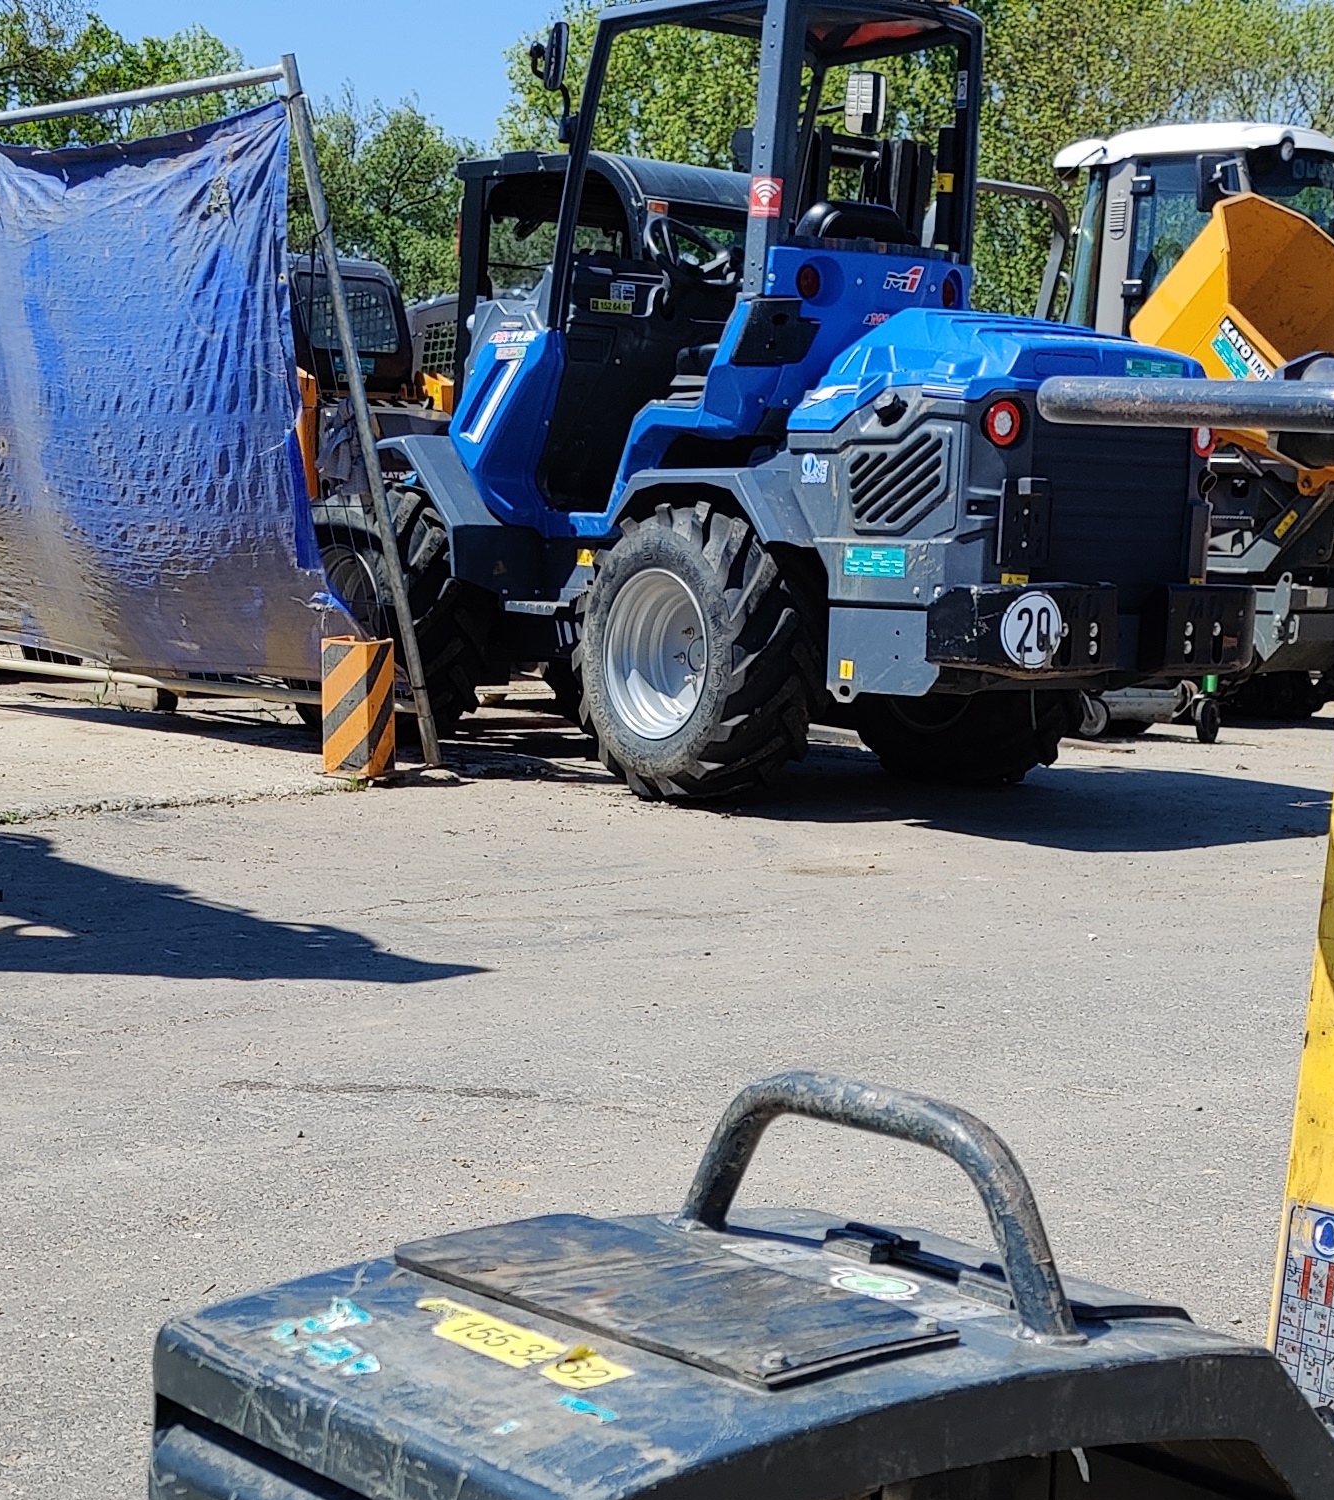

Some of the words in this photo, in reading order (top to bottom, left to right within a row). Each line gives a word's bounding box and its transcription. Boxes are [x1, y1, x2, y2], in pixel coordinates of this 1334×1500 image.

[1220, 317, 1252, 363] KATO
[1017, 606, 1051, 653] 20
[452, 1321, 521, 1348] 155
[555, 1357, 612, 1384] 62
